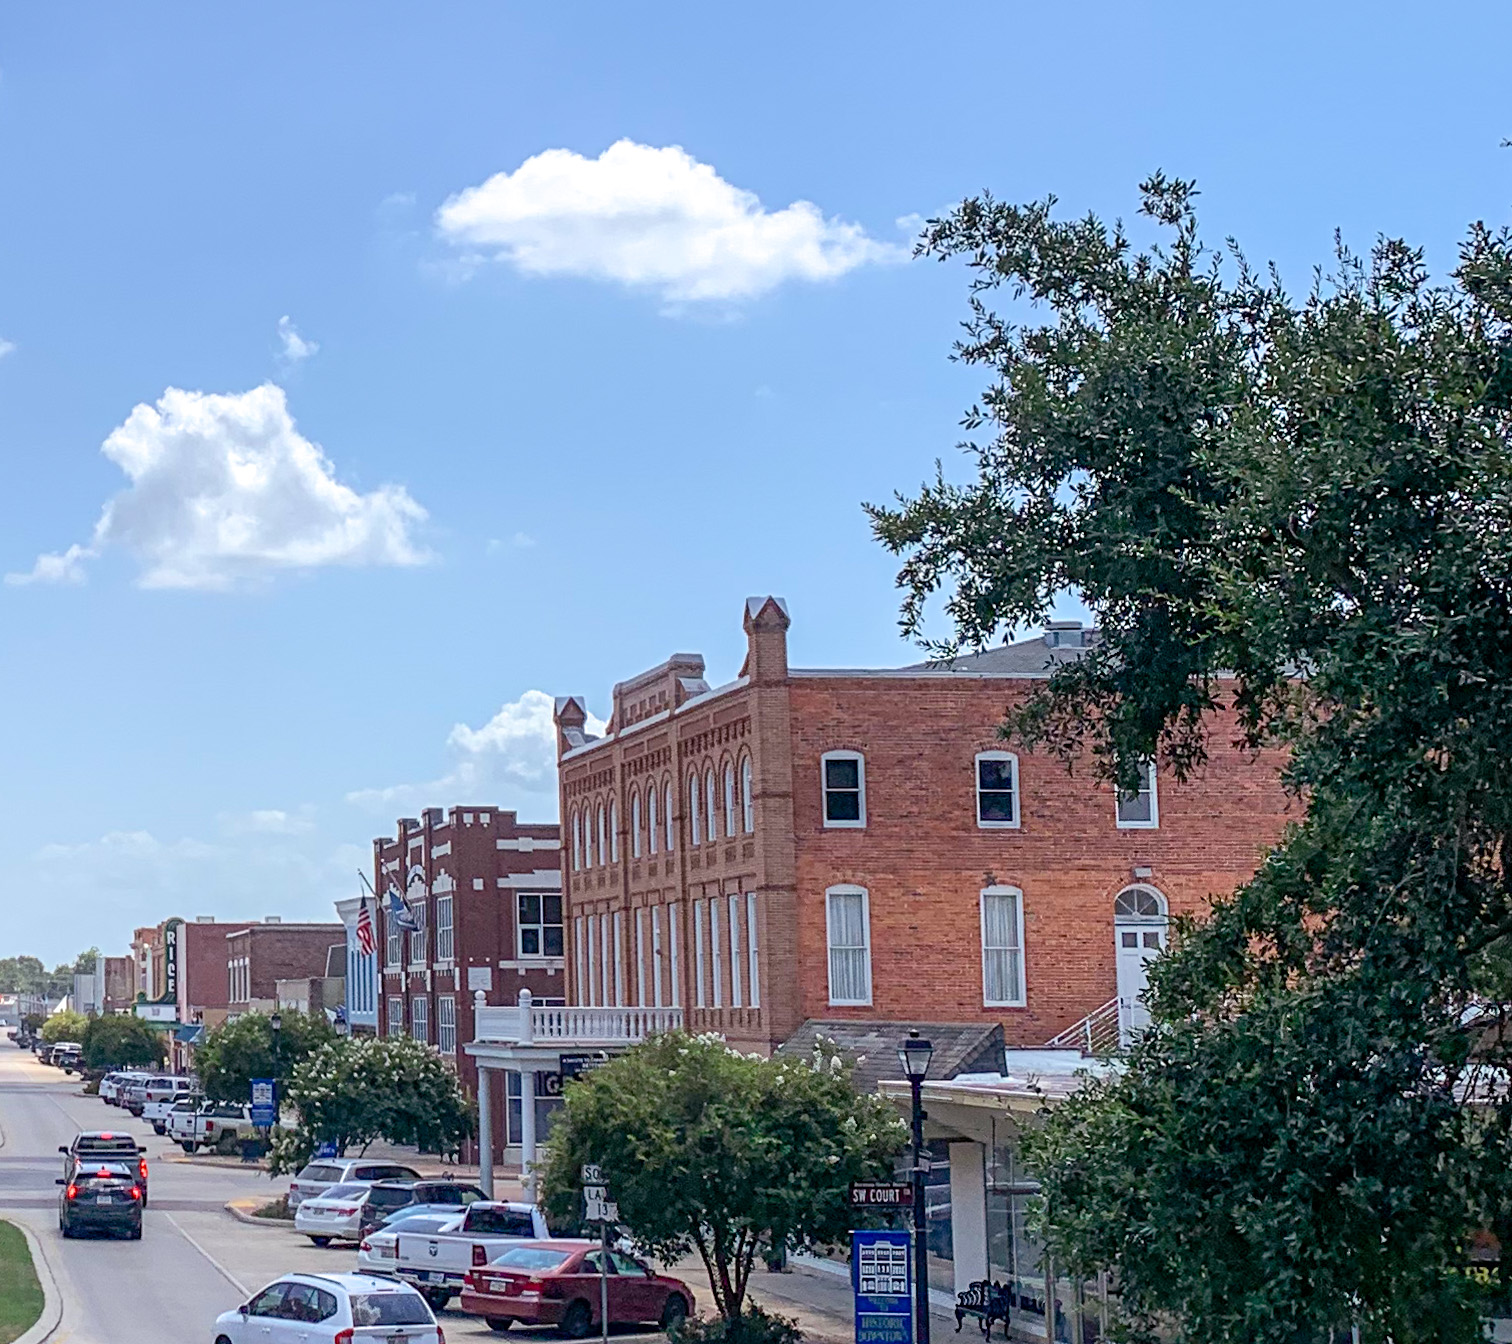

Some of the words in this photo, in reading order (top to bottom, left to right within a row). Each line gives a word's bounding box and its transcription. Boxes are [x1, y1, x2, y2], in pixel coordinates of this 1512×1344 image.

[166, 931, 176, 993] RICE
[588, 1188, 601, 1200] LA
[852, 1189, 866, 1203] SW
[869, 1189, 900, 1203] COURT
[598, 1203, 608, 1215] 13
